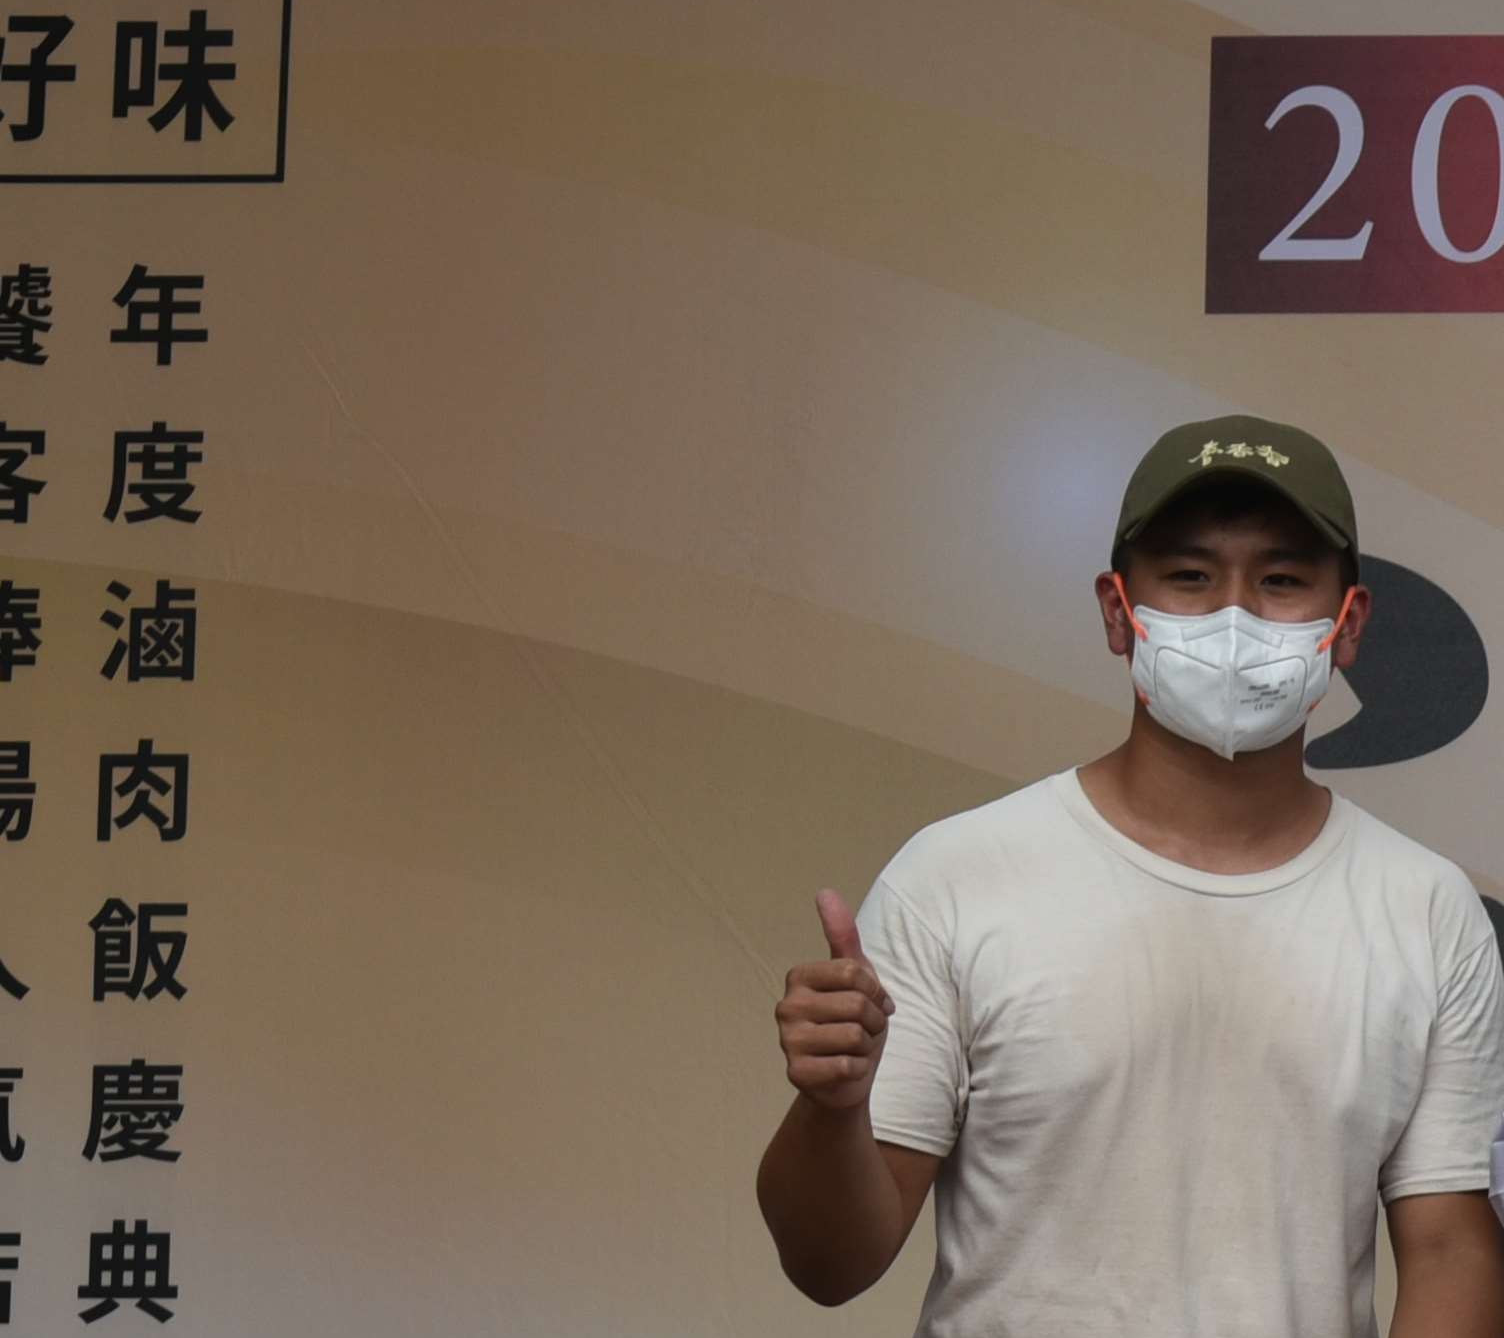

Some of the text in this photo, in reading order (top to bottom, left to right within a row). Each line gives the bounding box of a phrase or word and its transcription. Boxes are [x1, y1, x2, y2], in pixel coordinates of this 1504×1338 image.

[78, 263, 209, 1325] 年度滷肉飯慶典
